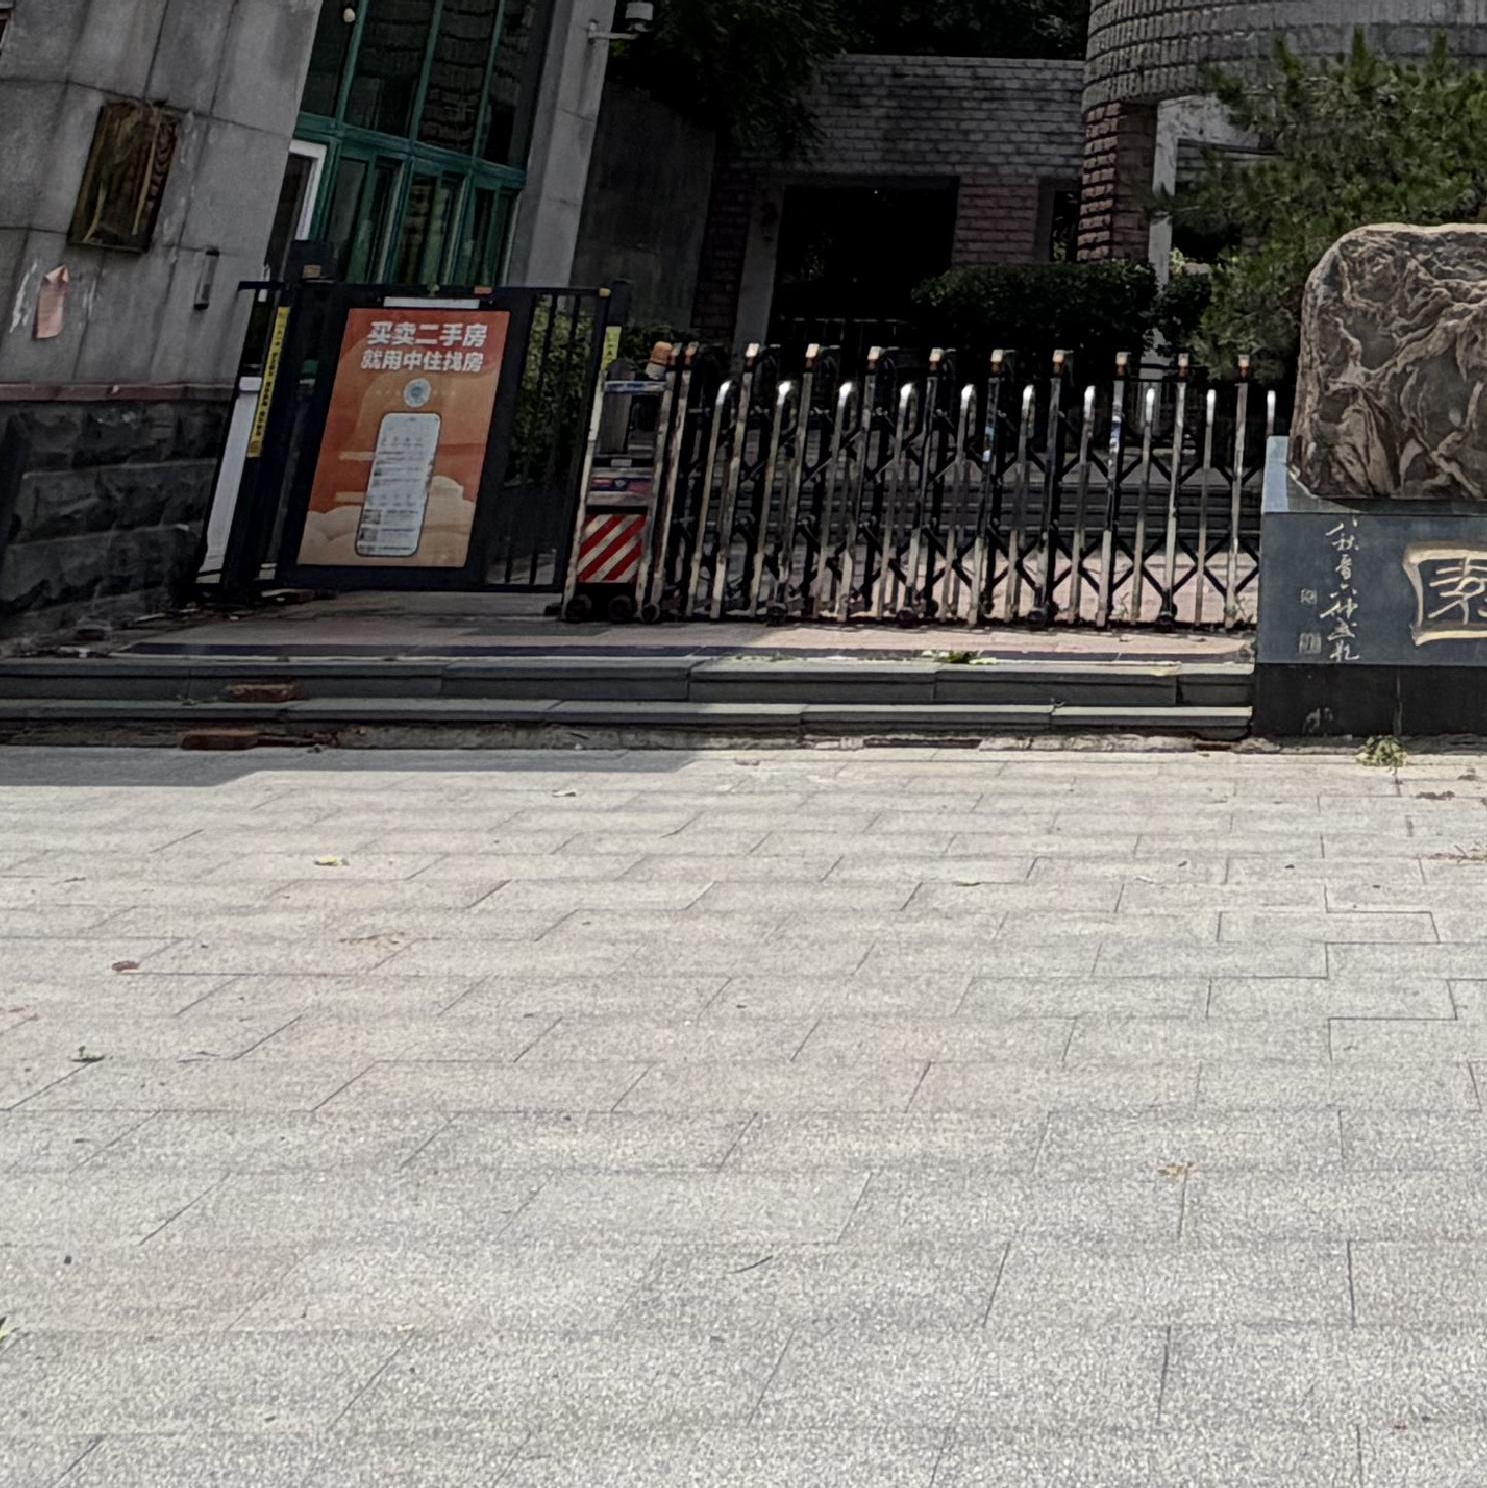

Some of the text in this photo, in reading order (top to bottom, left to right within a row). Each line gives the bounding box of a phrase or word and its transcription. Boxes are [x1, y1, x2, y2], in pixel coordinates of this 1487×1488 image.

[367, 320, 488, 347] 买卖二手房
[361, 350, 484, 372] 就用中住找房
